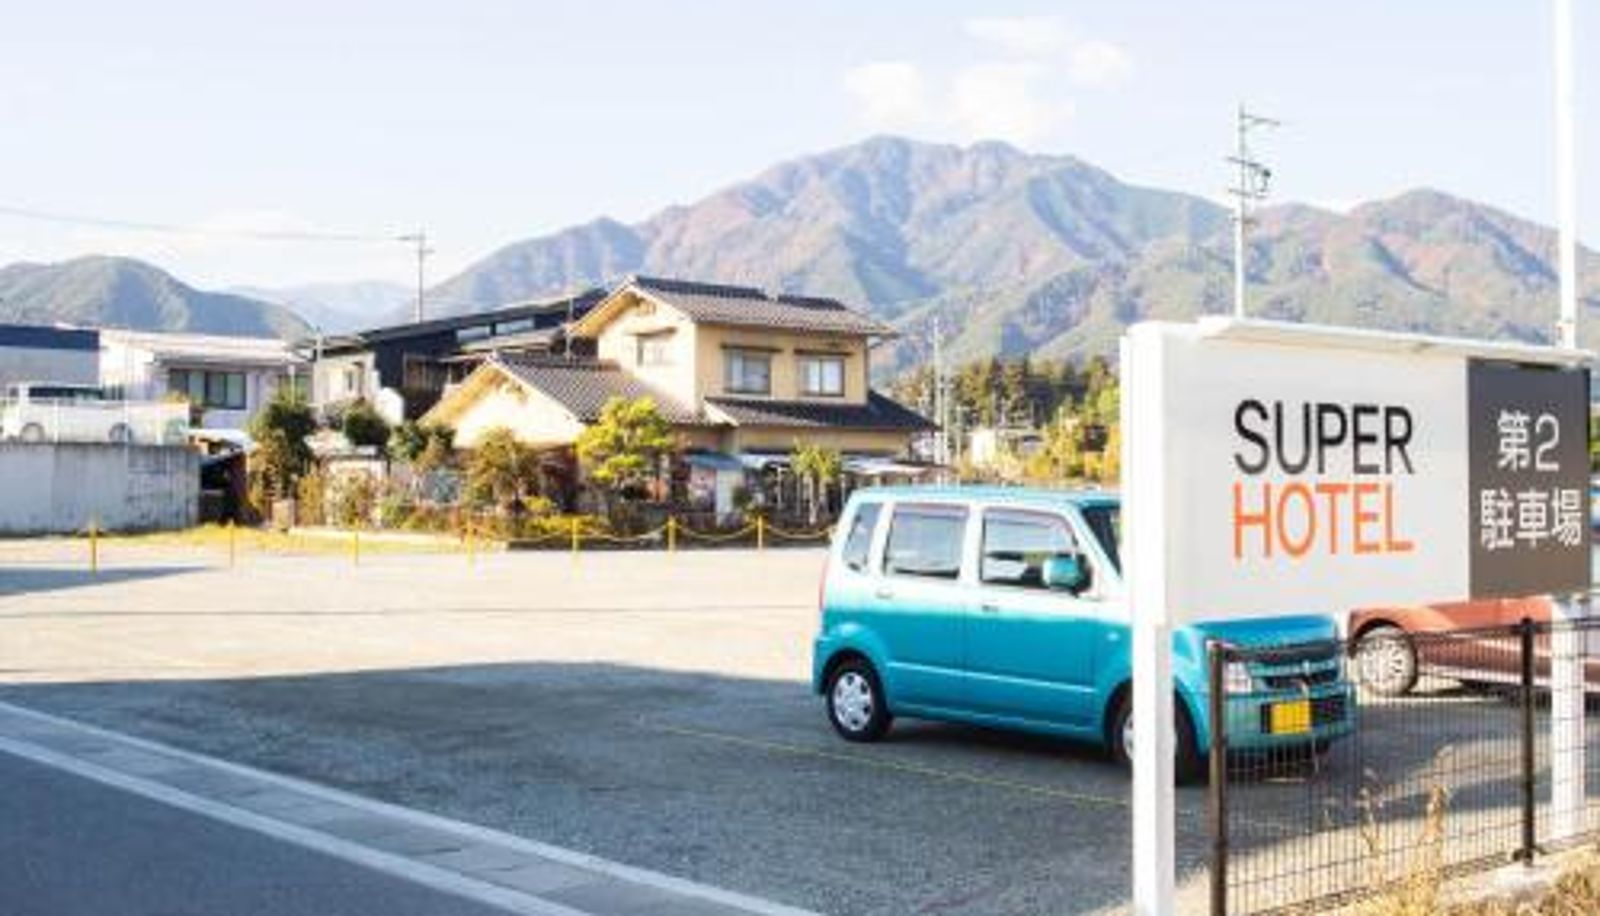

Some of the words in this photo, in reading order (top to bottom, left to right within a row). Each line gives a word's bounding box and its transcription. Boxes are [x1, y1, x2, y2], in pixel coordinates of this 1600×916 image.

[1233, 398, 1415, 475] SUPER
[1497, 408, 1560, 473] 第2
[1233, 481, 1415, 559] HOTEL
[1479, 487, 1583, 550] 駐車場
